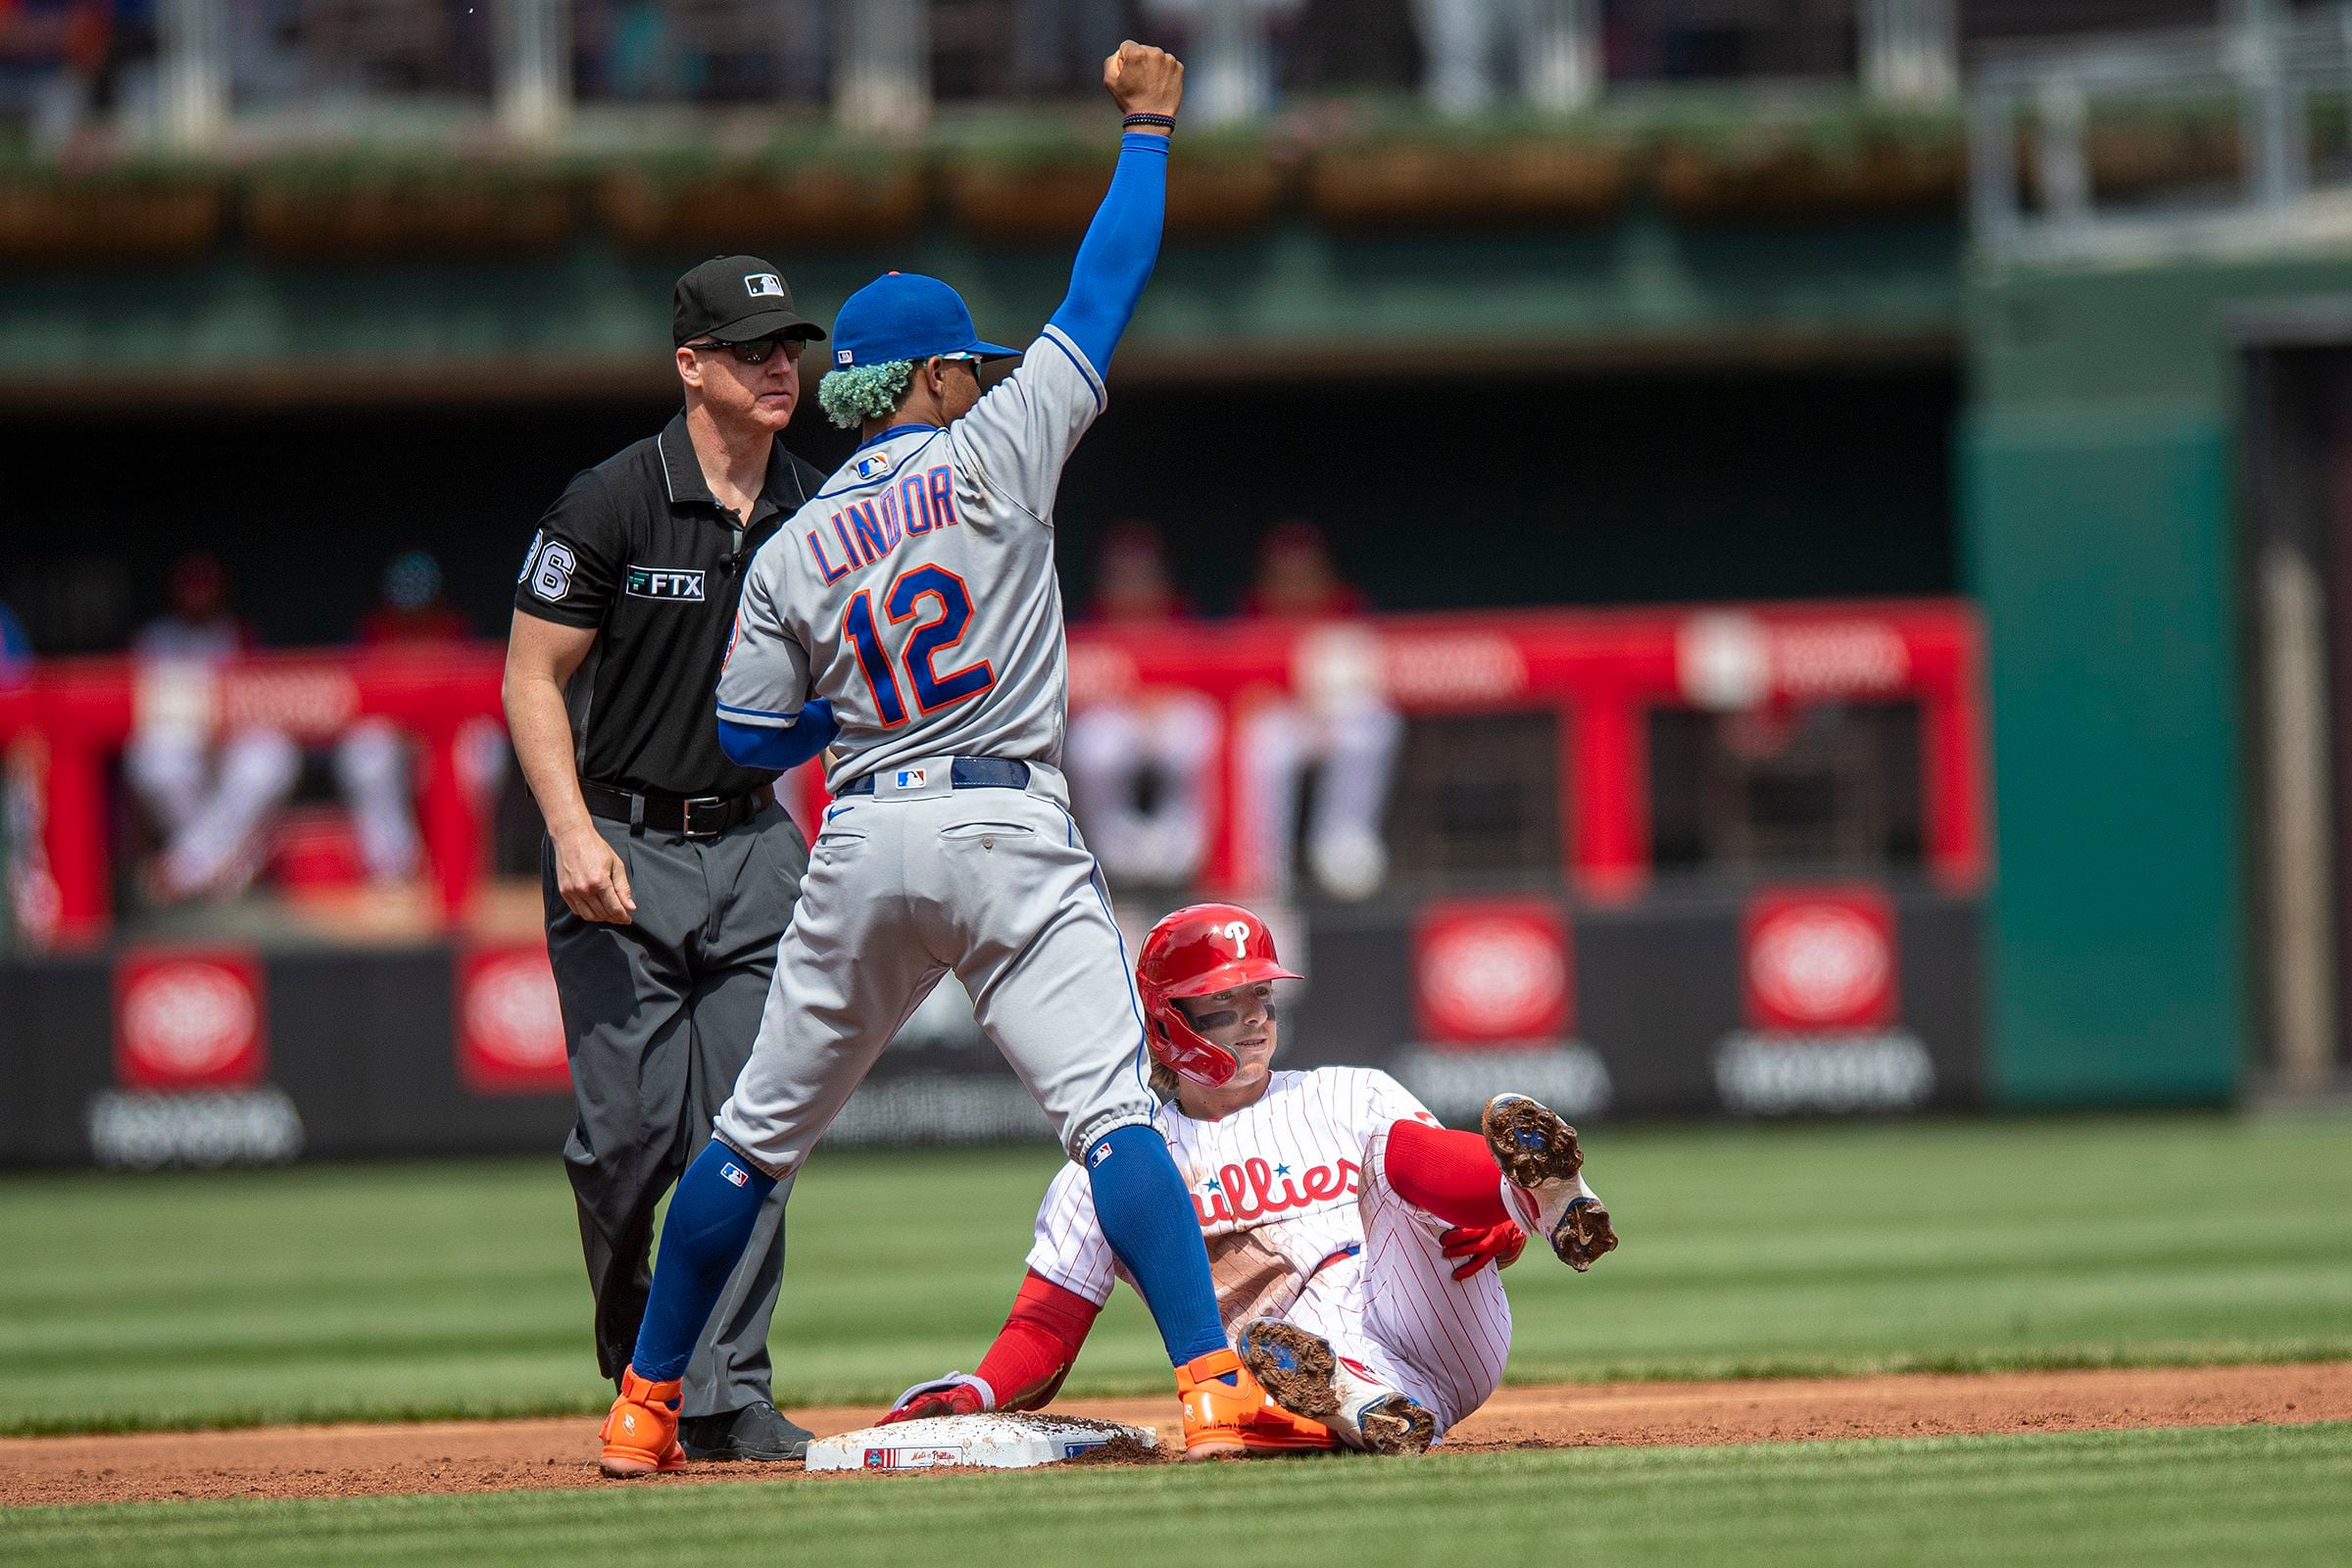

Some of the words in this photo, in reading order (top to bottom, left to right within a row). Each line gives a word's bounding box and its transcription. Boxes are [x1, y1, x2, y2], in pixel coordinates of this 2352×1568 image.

[807, 464, 958, 587] LINDOR
[651, 572, 703, 597] FTX
[842, 562, 997, 730] 12
[1224, 920, 1250, 959] P
[1190, 1156, 1360, 1227] illies
